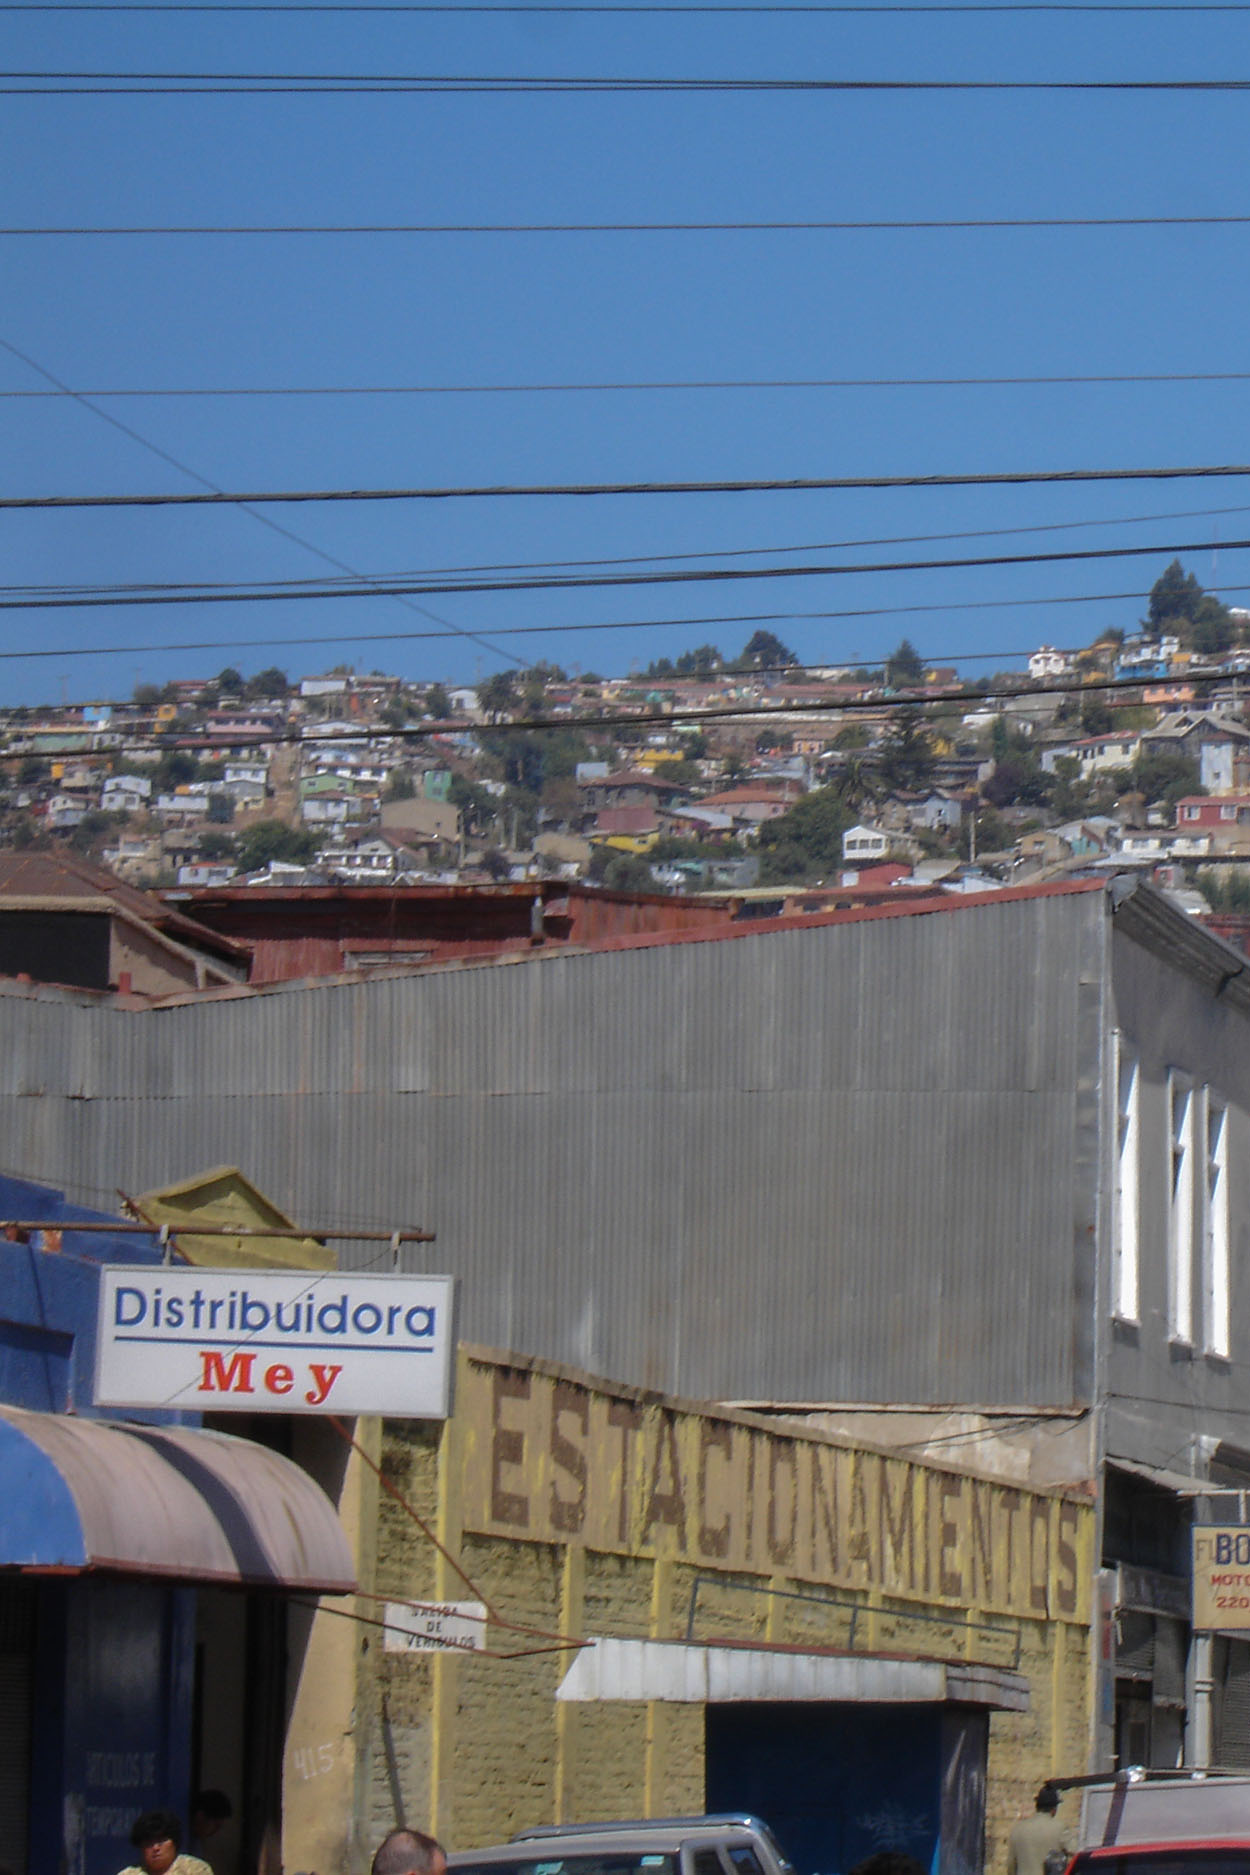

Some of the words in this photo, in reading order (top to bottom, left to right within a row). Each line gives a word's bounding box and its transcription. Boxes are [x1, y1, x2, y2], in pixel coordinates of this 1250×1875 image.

[114, 1286, 436, 1337] Distribuidora
[198, 1351, 343, 1405] Mey
[491, 1371, 1077, 1613] ESTACIONAMIENTOS
[426, 1621, 442, 1632] DE
[293, 1743, 334, 1781] 415
